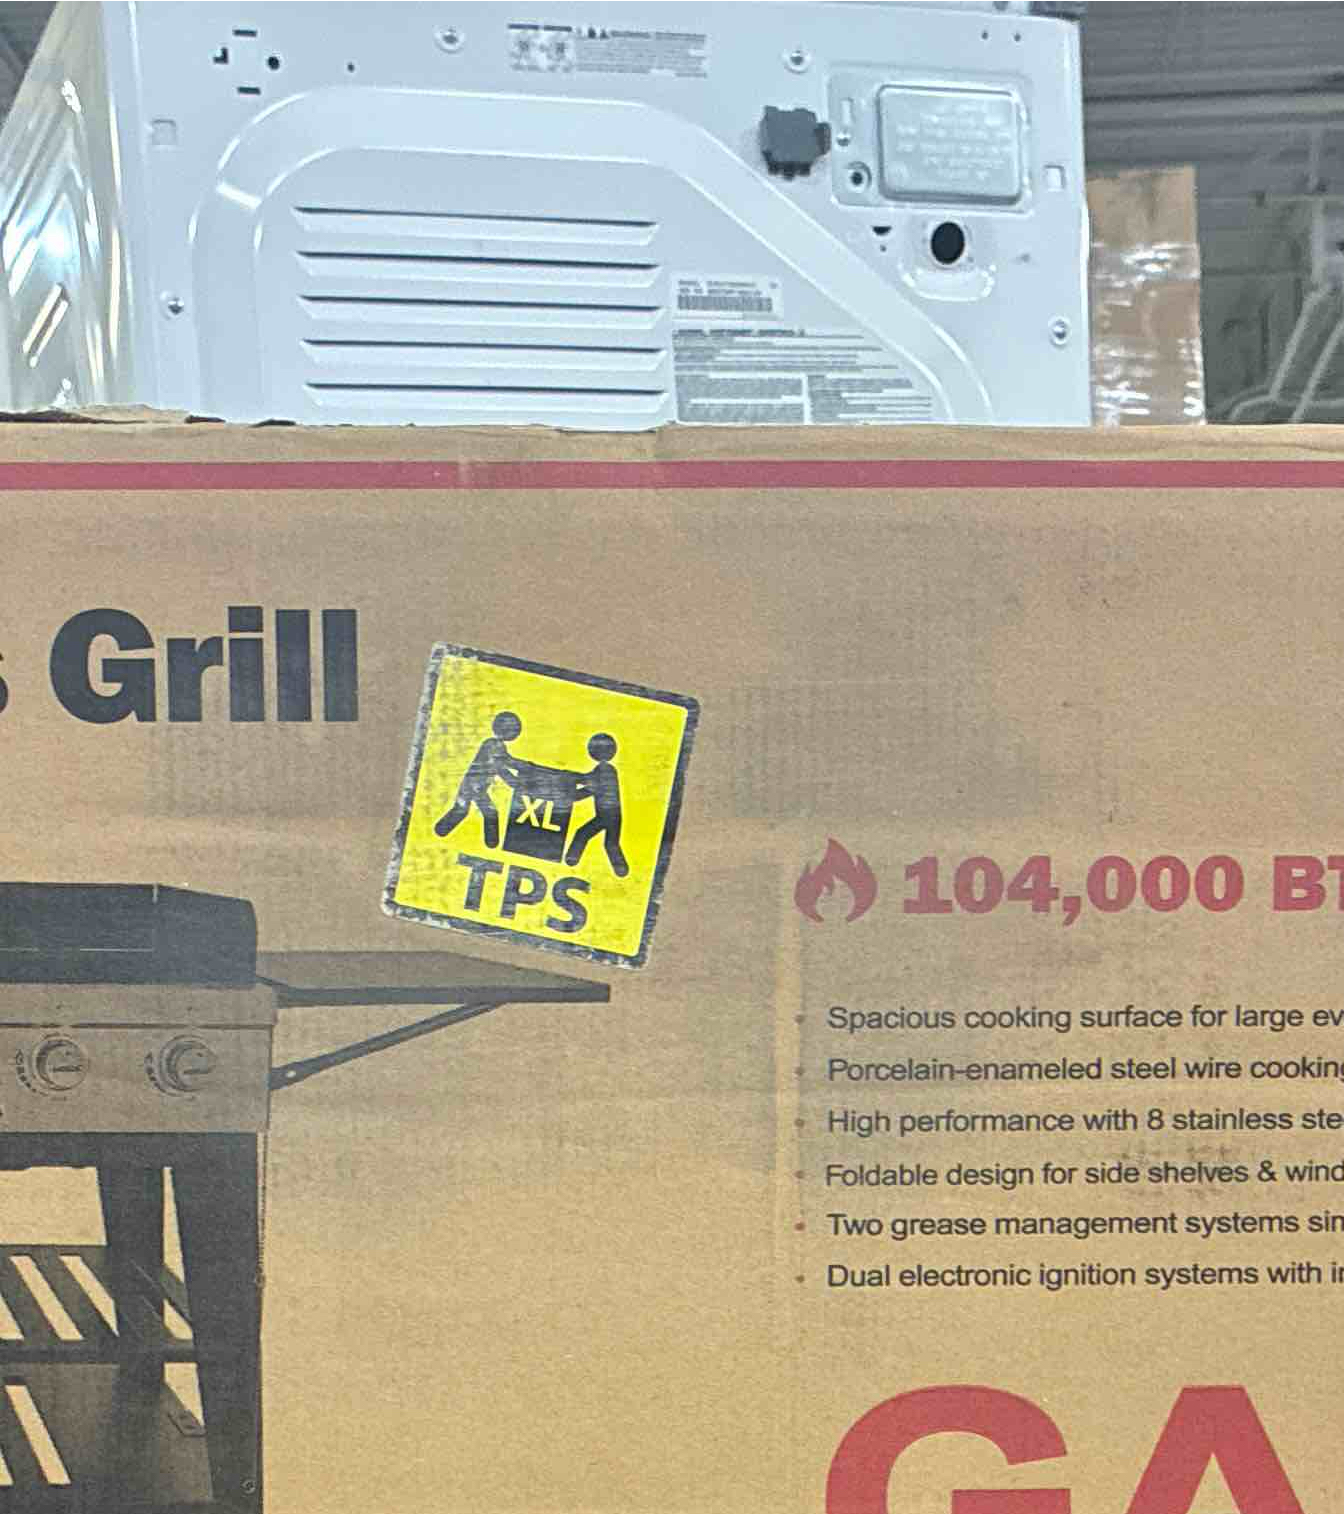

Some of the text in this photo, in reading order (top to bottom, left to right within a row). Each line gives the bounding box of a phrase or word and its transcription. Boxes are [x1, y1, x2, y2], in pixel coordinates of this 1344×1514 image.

[49, 605, 359, 723] Grill
[515, 795, 563, 832] XL
[457, 853, 592, 934] TPS
[903, 854, 1244, 926] 104,000
[827, 1006, 955, 1033] Spacious
[964, 1006, 1071, 1033] cooking
[1080, 1005, 1182, 1028] surface
[1192, 1005, 1227, 1027] for
[1236, 1005, 1304, 1032] large
[828, 1057, 1102, 1081] Porcelain-enameled
[1111, 1057, 1176, 1079] steel
[1186, 1058, 1242, 1078] wire
[828, 1110, 890, 1137] High
[900, 1109, 1075, 1137] performance
[1083, 1109, 1138, 1131] with
[1147, 1109, 1164, 1131] 8
[1173, 1108, 1293, 1130] stainless
[826, 1163, 937, 1186] Foldable
[946, 1162, 1034, 1190] design
[1042, 1162, 1077, 1184] for
[1085, 1161, 1139, 1184] side
[1148, 1161, 1249, 1184] shelves
[1258, 1161, 1276, 1182] &
[827, 1213, 883, 1236] Two
[891, 1216, 986, 1241] grease
[995, 1213, 1177, 1240] management
[1185, 1212, 1299, 1238] systems
[827, 1264, 890, 1287] Dual
[900, 1263, 1031, 1286] electronic
[1040, 1263, 1136, 1291] ignition
[1145, 1263, 1258, 1289] systems
[1267, 1262, 1322, 1284] with
